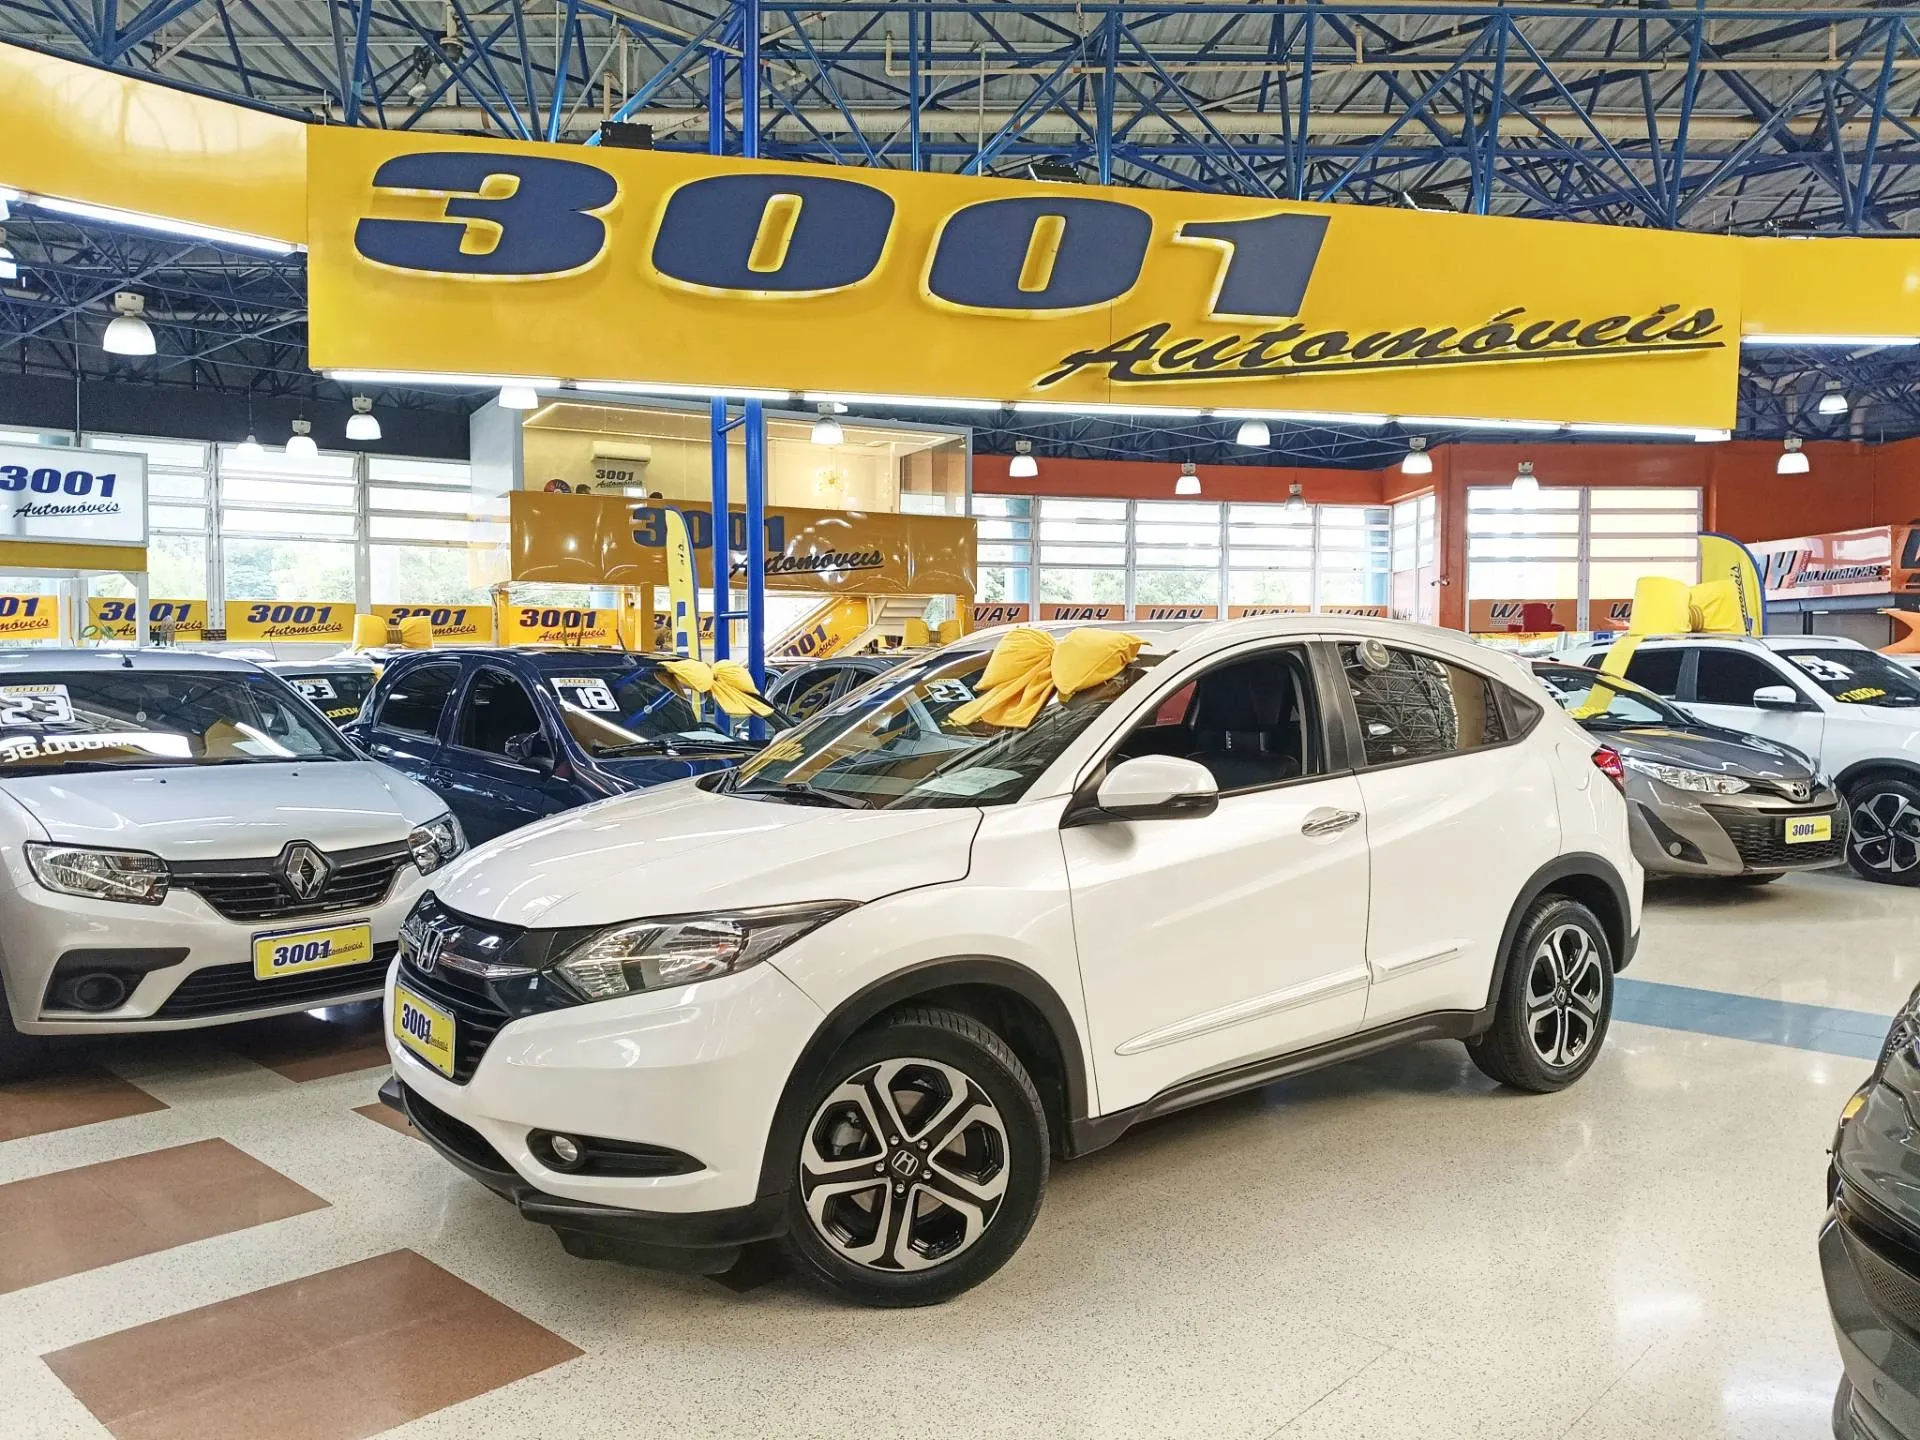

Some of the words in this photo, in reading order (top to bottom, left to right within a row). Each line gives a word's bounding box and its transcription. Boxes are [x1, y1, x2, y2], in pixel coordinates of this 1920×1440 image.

[353, 151, 1330, 323] 3001
[1033, 303, 1726, 389] Automóveis
[0, 465, 117, 498] 3001
[595, 469, 634, 481] 3001
[12, 501, 121, 518] Automóveis
[247, 604, 333, 624] 3001
[519, 608, 598, 629] 3001
[1055, 607, 1109, 620] WAY
[261, 621, 345, 638] Automóveis
[432, 623, 479, 637] móveis
[575, 687, 617, 710] 18
[926, 685, 970, 701] 23
[0, 697, 71, 723] 23
[1792, 823, 1815, 837] 3001
[273, 939, 331, 967] 3001
[401, 1003, 432, 1045] 3001
